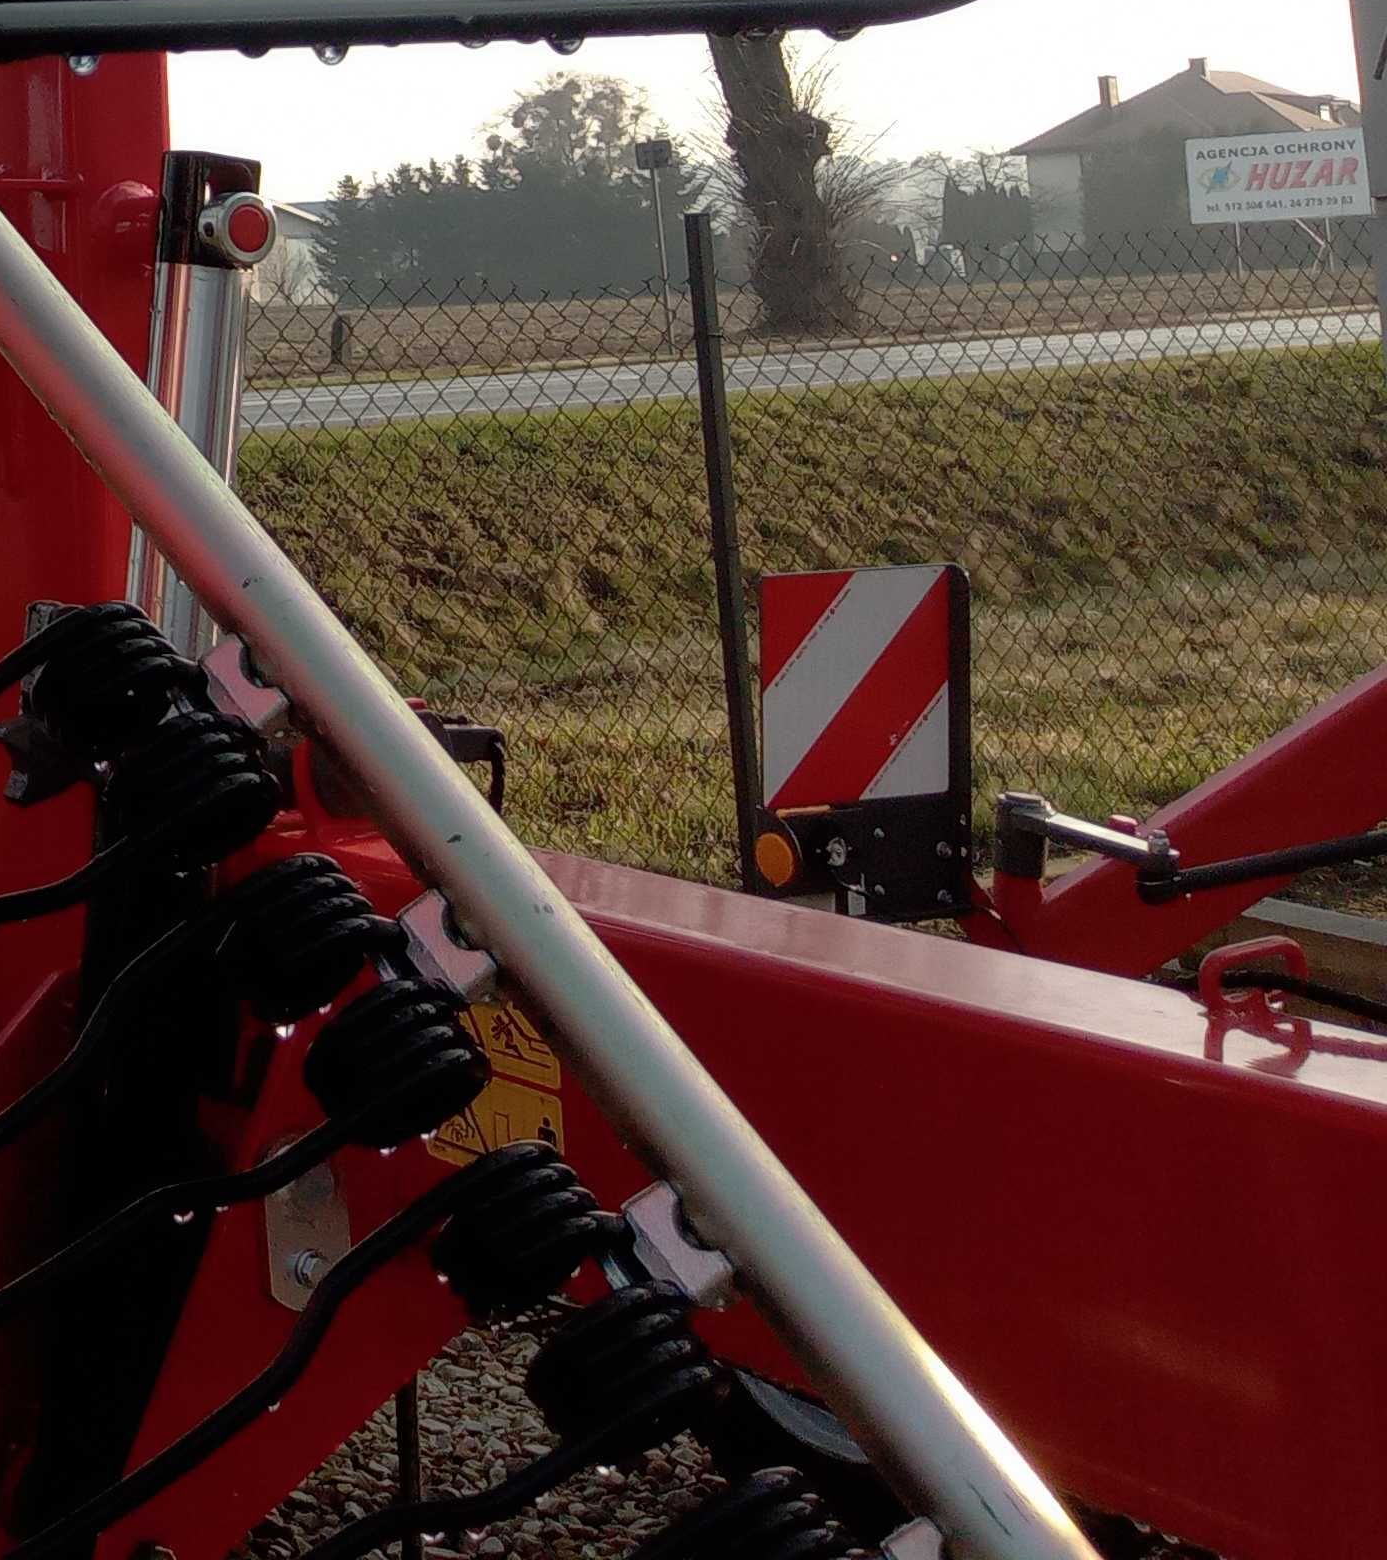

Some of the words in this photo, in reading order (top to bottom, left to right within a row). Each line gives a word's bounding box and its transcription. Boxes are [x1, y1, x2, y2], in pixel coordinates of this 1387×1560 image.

[1195, 145, 1269, 161] AGENCJA
[1274, 139, 1357, 155] OCHRONY
[1244, 157, 1359, 191] HUZAR
